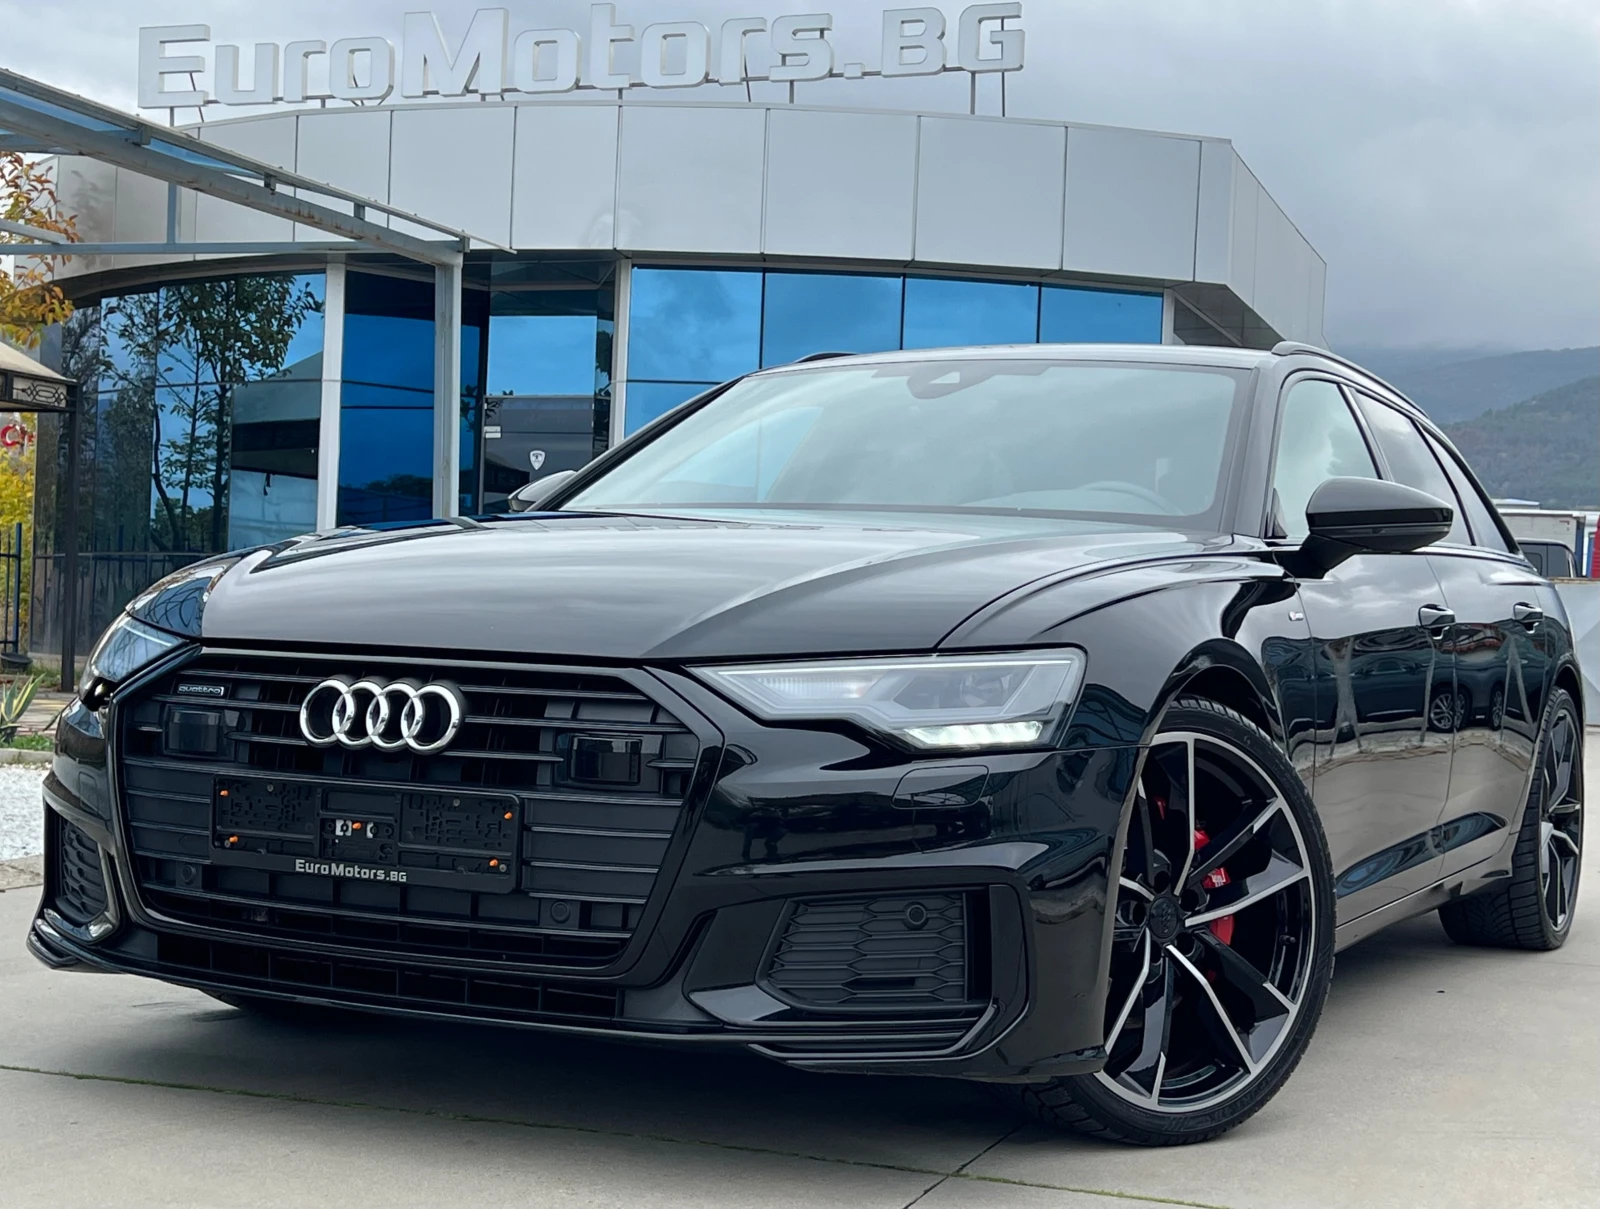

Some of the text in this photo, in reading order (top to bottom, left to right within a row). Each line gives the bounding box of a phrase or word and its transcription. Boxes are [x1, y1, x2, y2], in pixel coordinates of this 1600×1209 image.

[138, 2, 1025, 108] EuroMotors.BG
[178, 685, 221, 695] quattro
[295, 859, 407, 883] EuroMotors.BG
